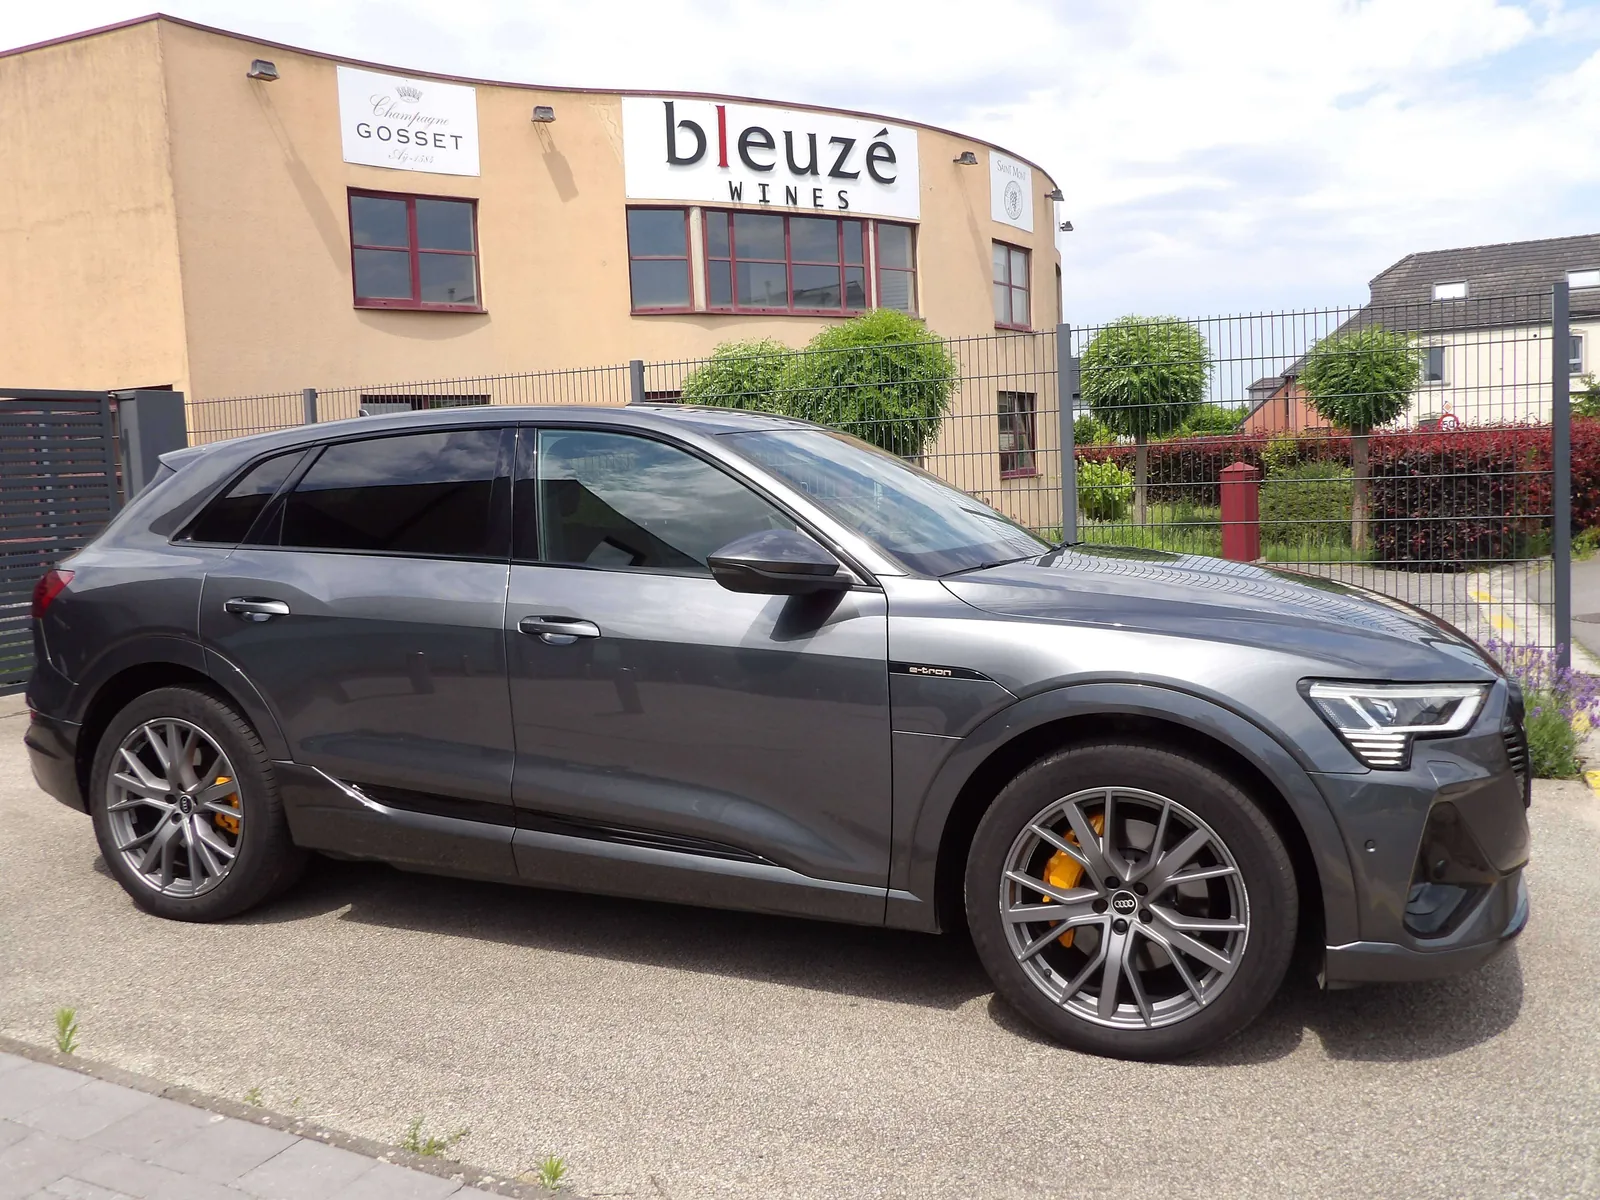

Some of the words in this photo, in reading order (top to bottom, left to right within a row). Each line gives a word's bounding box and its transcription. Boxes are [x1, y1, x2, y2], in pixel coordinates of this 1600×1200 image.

[369, 94, 449, 129] Champagne
[356, 122, 463, 150] GOSSET
[663, 101, 897, 185] bleuzé
[729, 181, 850, 210] WINES
[909, 666, 952, 676] e-tron
